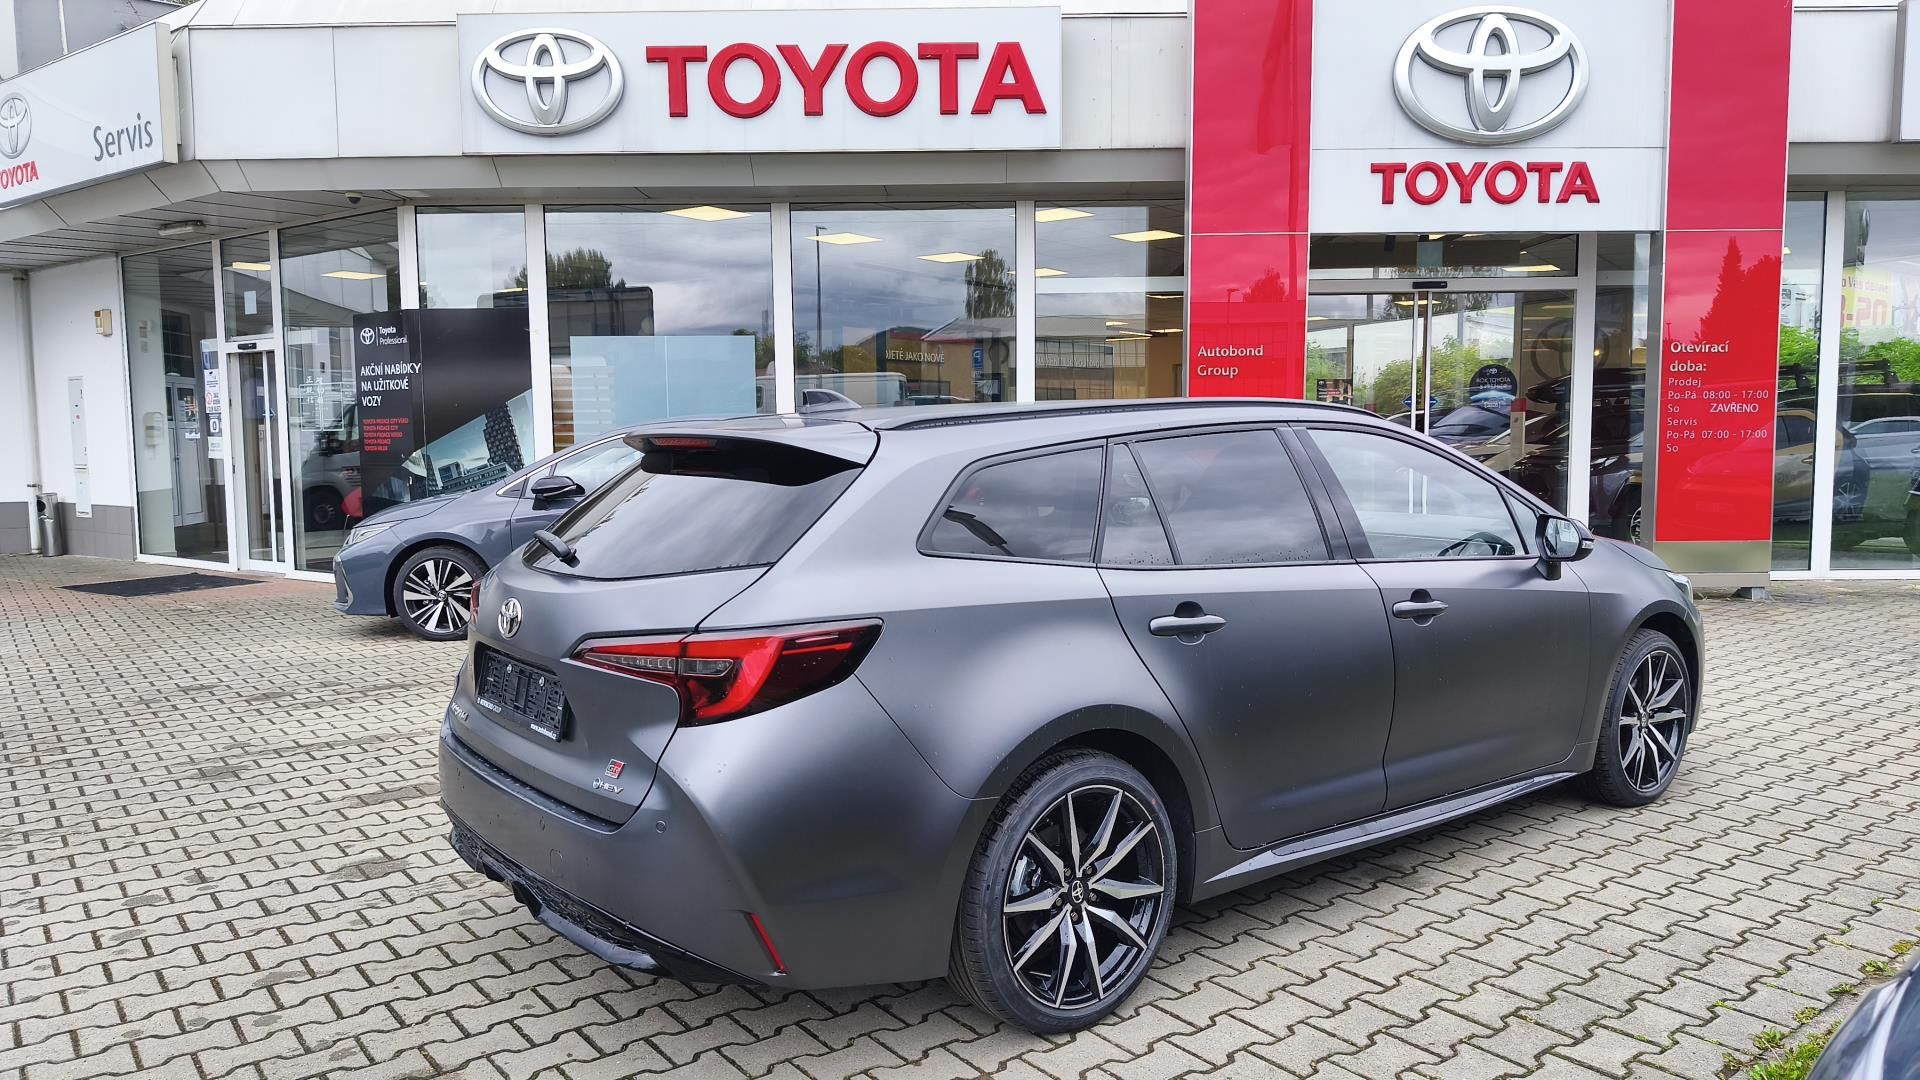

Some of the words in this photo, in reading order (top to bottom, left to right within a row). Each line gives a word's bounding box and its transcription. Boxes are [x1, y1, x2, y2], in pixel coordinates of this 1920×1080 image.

[645, 40, 1048, 119] TOYOTA
[93, 112, 153, 162] Servis
[0, 160, 39, 190] OYOTA
[1370, 160, 1601, 206] TOYOTA
[378, 326, 397, 335] Toyota
[379, 335, 408, 345] Professional
[1197, 344, 1264, 357] Autobond
[1670, 340, 1730, 353] Otevírací
[360, 362, 384, 377] AKČNÍ
[384, 360, 421, 375] NABÍDKY
[1197, 364, 1239, 379] Group
[1669, 360, 1707, 372] doba:
[361, 380, 373, 391] NA
[373, 376, 409, 391] UŽITKOVÉ
[1668, 377, 1702, 388] Prodej
[361, 395, 382, 407] VOZY
[1667, 390, 1697, 400] Po-Pá
[1702, 390, 1731, 399] 08:00
[1742, 390, 1769, 399] 17:00
[1667, 404, 1680, 413] So
[1710, 402, 1759, 413] ZAVŘENO
[1667, 417, 1698, 426] Servis
[1666, 430, 1696, 439] Po-Pá
[1701, 430, 1730, 439] 07:00
[1741, 430, 1768, 438] 17:00
[1666, 443, 1679, 453] So
